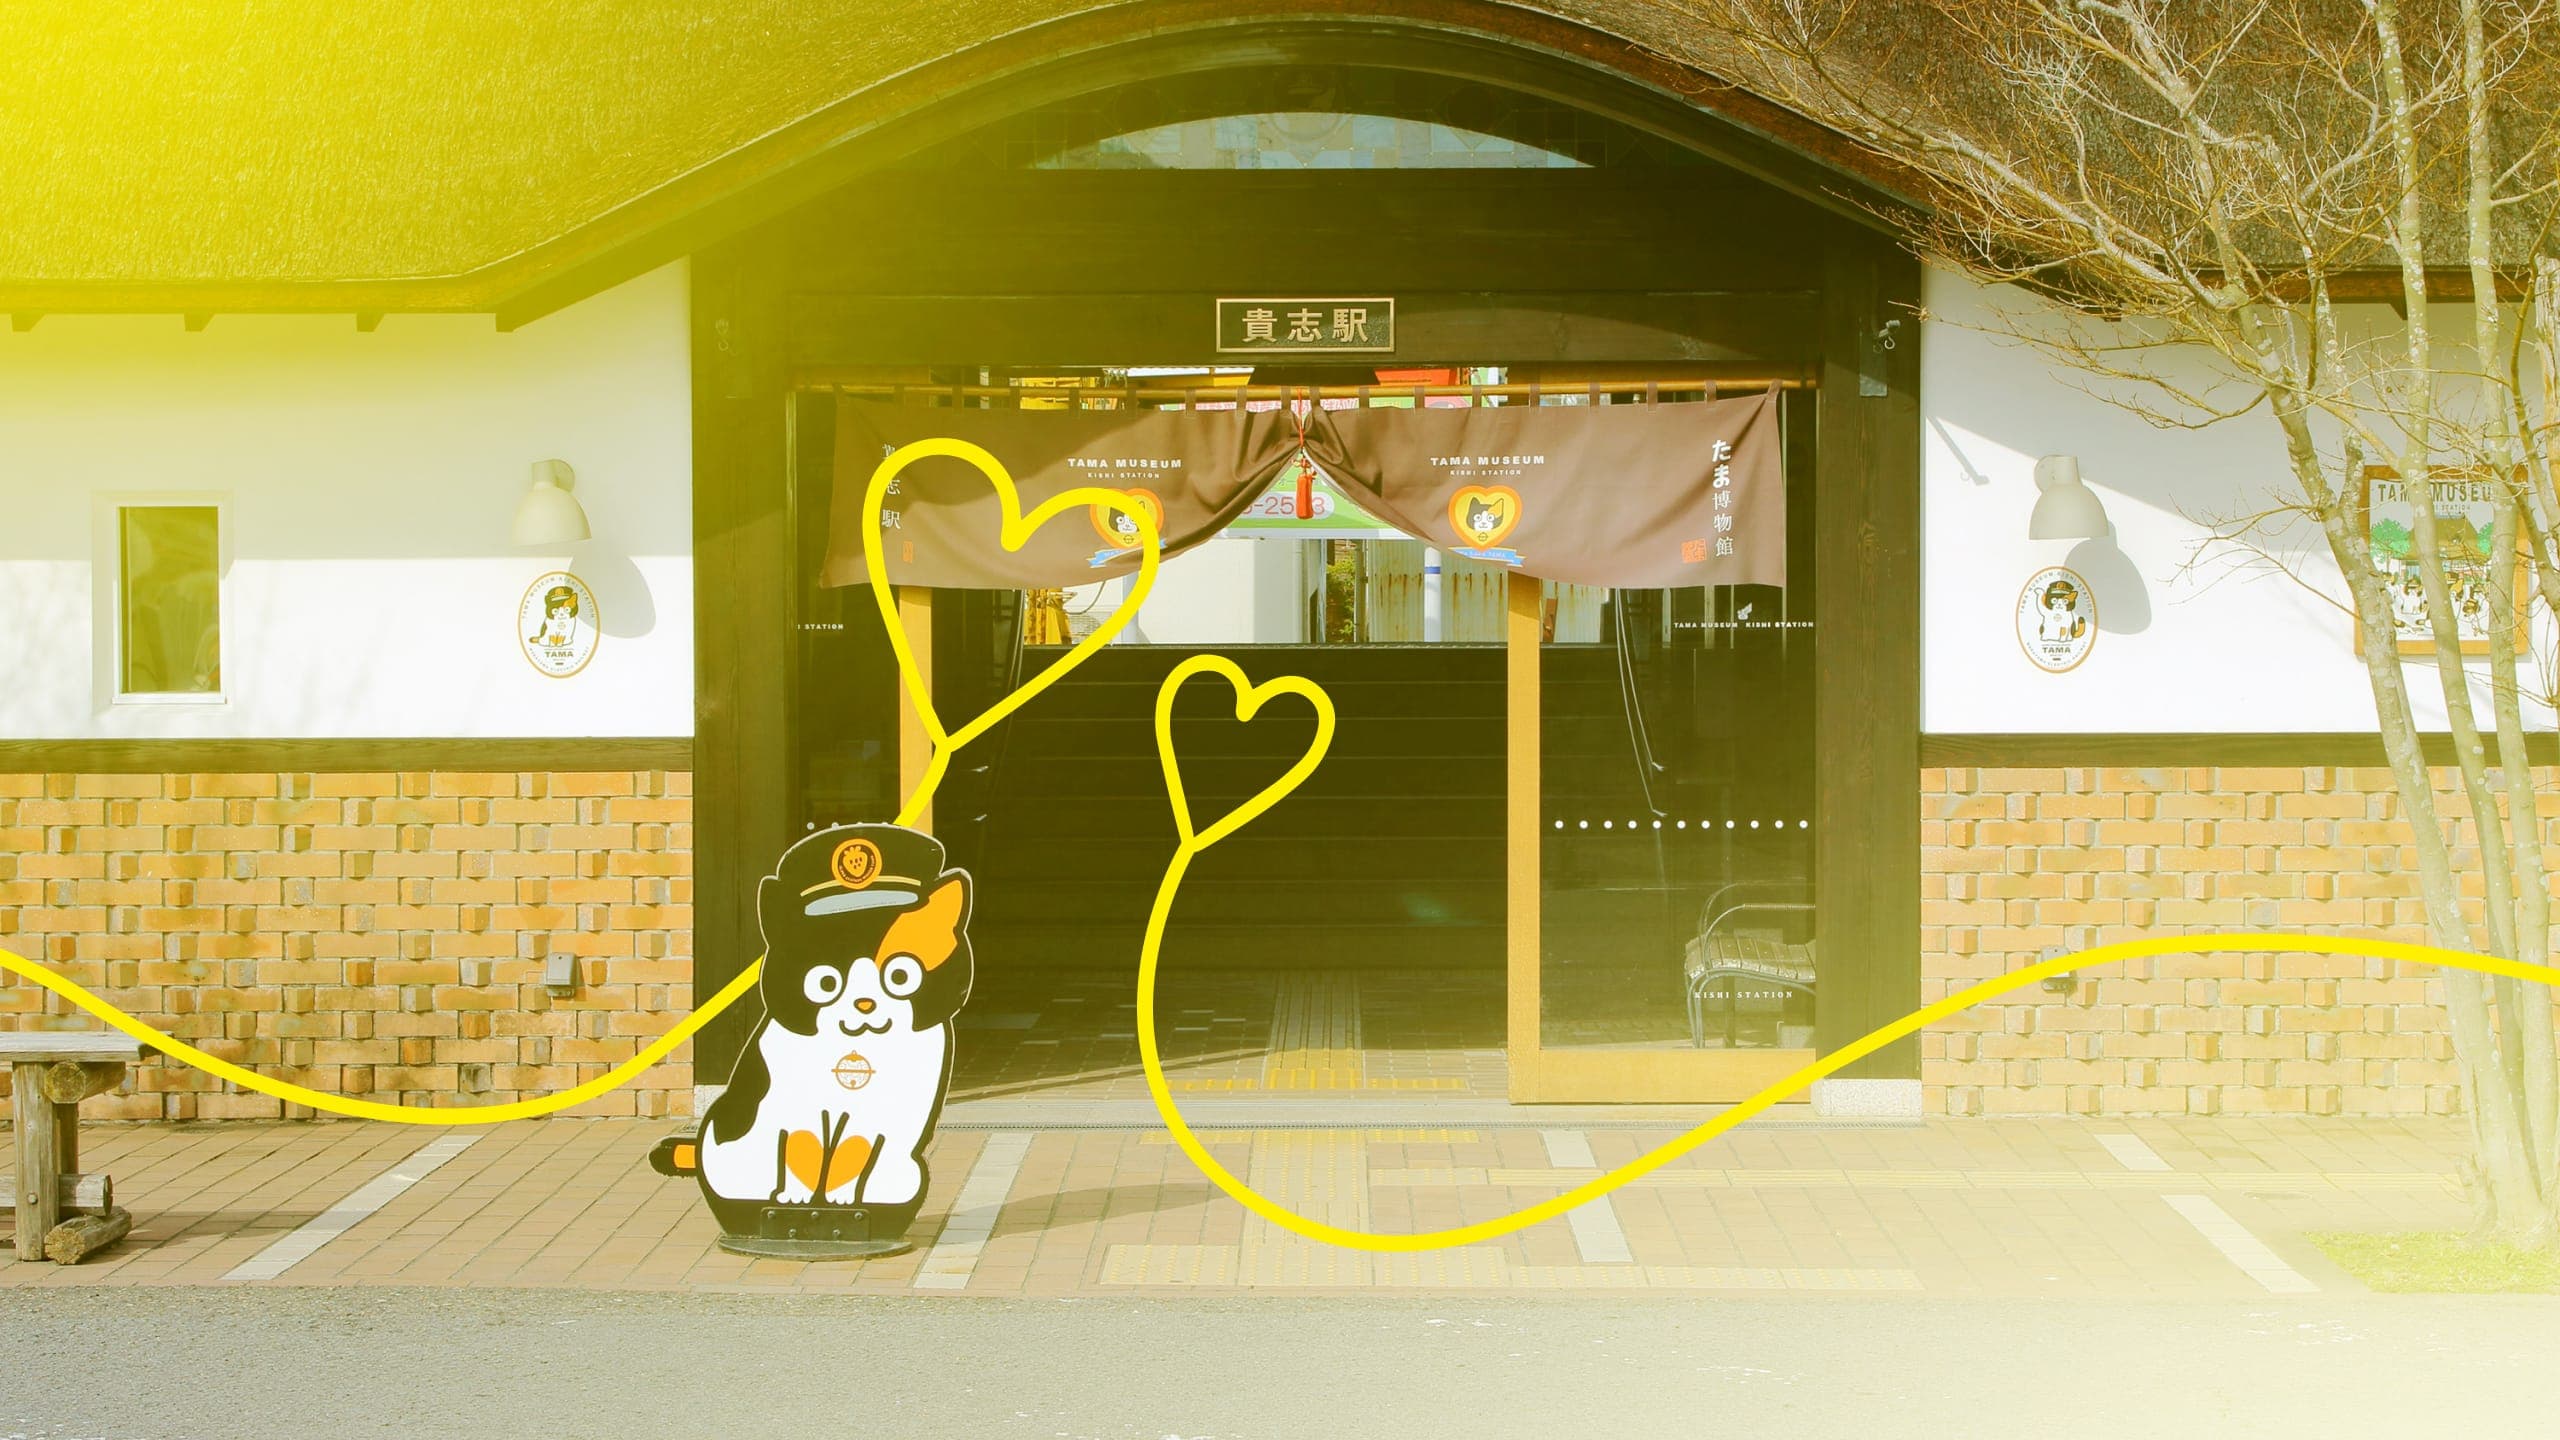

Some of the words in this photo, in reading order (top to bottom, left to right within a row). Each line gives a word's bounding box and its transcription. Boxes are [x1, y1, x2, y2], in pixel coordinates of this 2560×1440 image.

[1242, 307, 1369, 343] 貴志駅
[1067, 458, 1109, 468] TAMA
[1115, 458, 1182, 469] MUSEUM
[1430, 456, 1471, 466] TAMA
[1478, 455, 1545, 466] MUSEUM
[1711, 439, 1733, 557] たま博物館
[2378, 484, 2410, 502] TAM
[2432, 482, 2492, 502] MUSEU
[1242, 496, 1325, 515] -253
[1694, 991, 1730, 999] KISHI
[1737, 991, 1793, 999] STATION
